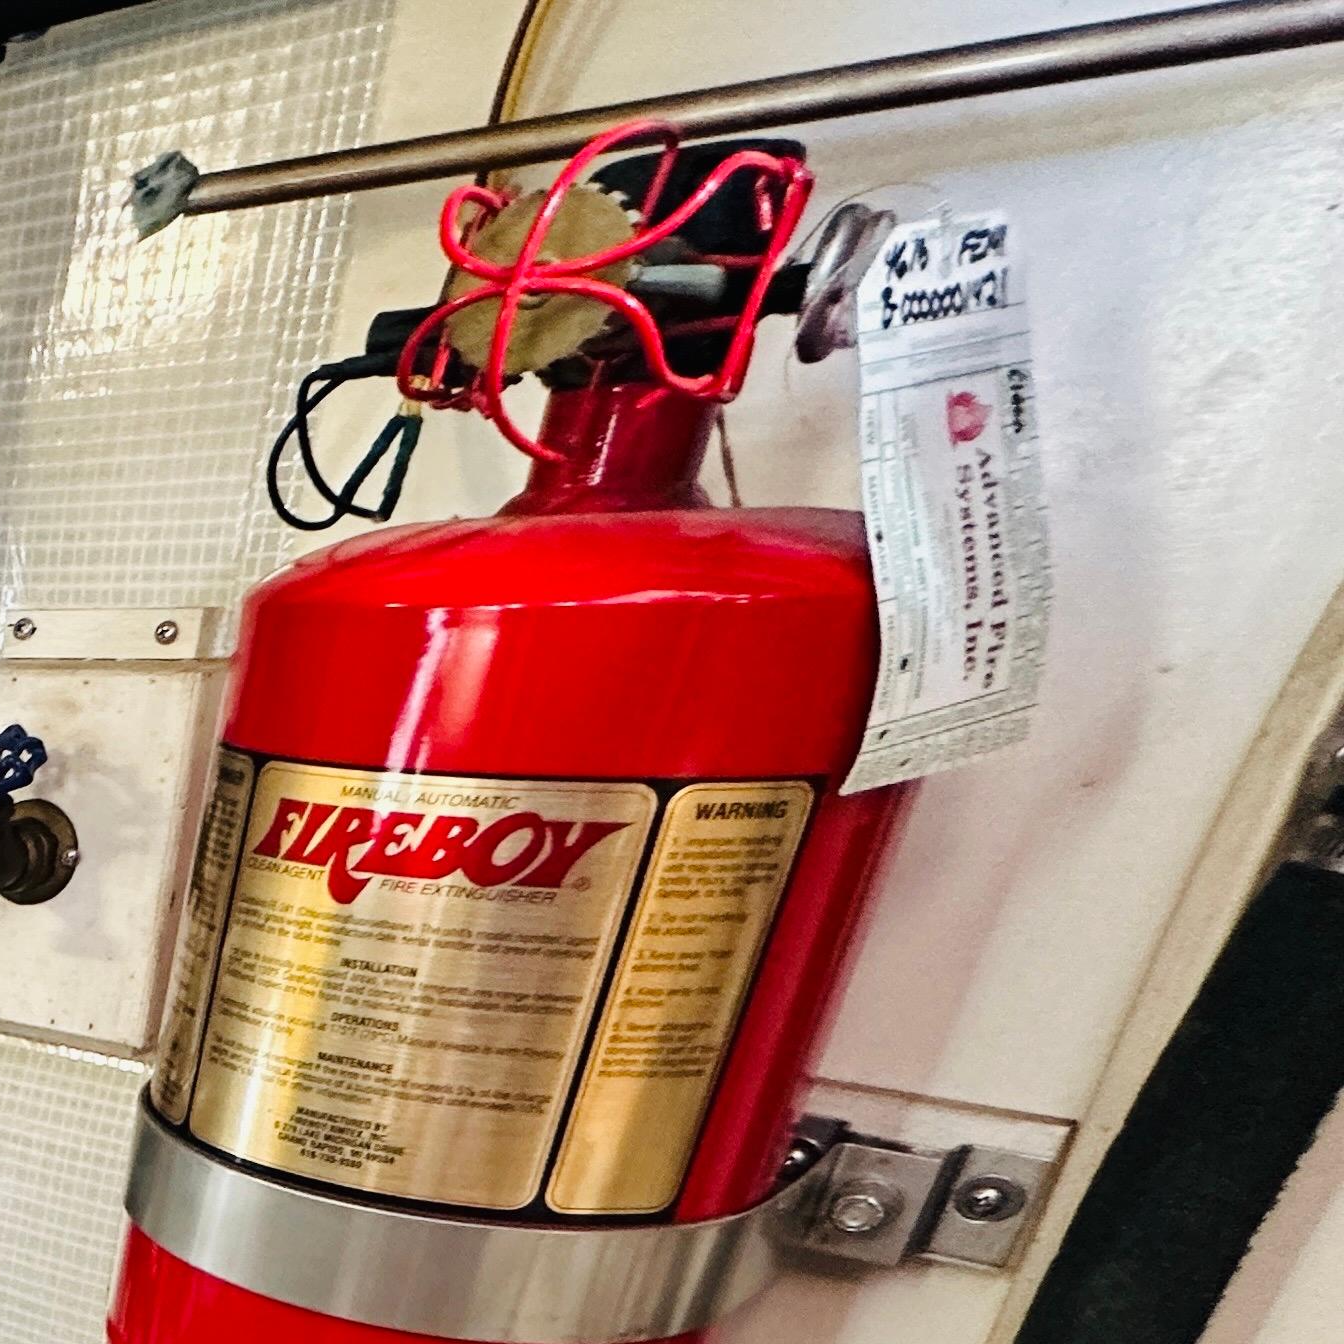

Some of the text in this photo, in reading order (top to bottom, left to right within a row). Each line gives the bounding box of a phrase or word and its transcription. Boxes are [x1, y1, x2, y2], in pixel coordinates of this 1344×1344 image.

[955, 463, 983, 682] Systems, Inc.
[976, 448, 1009, 690] Advanced Fire
[341, 784, 402, 804] MANUAL
[415, 788, 518, 811] AUTOMATIC
[695, 799, 789, 822] WARNING
[253, 798, 633, 904] FIREBOY
[285, 864, 326, 880] AGENT
[378, 878, 556, 902] FIRE EXTINGUISHER
[339, 956, 418, 979] INSTALLATION
[330, 1011, 400, 1032] OPERATIONS
[317, 1052, 394, 1074] MAINTENANCE
